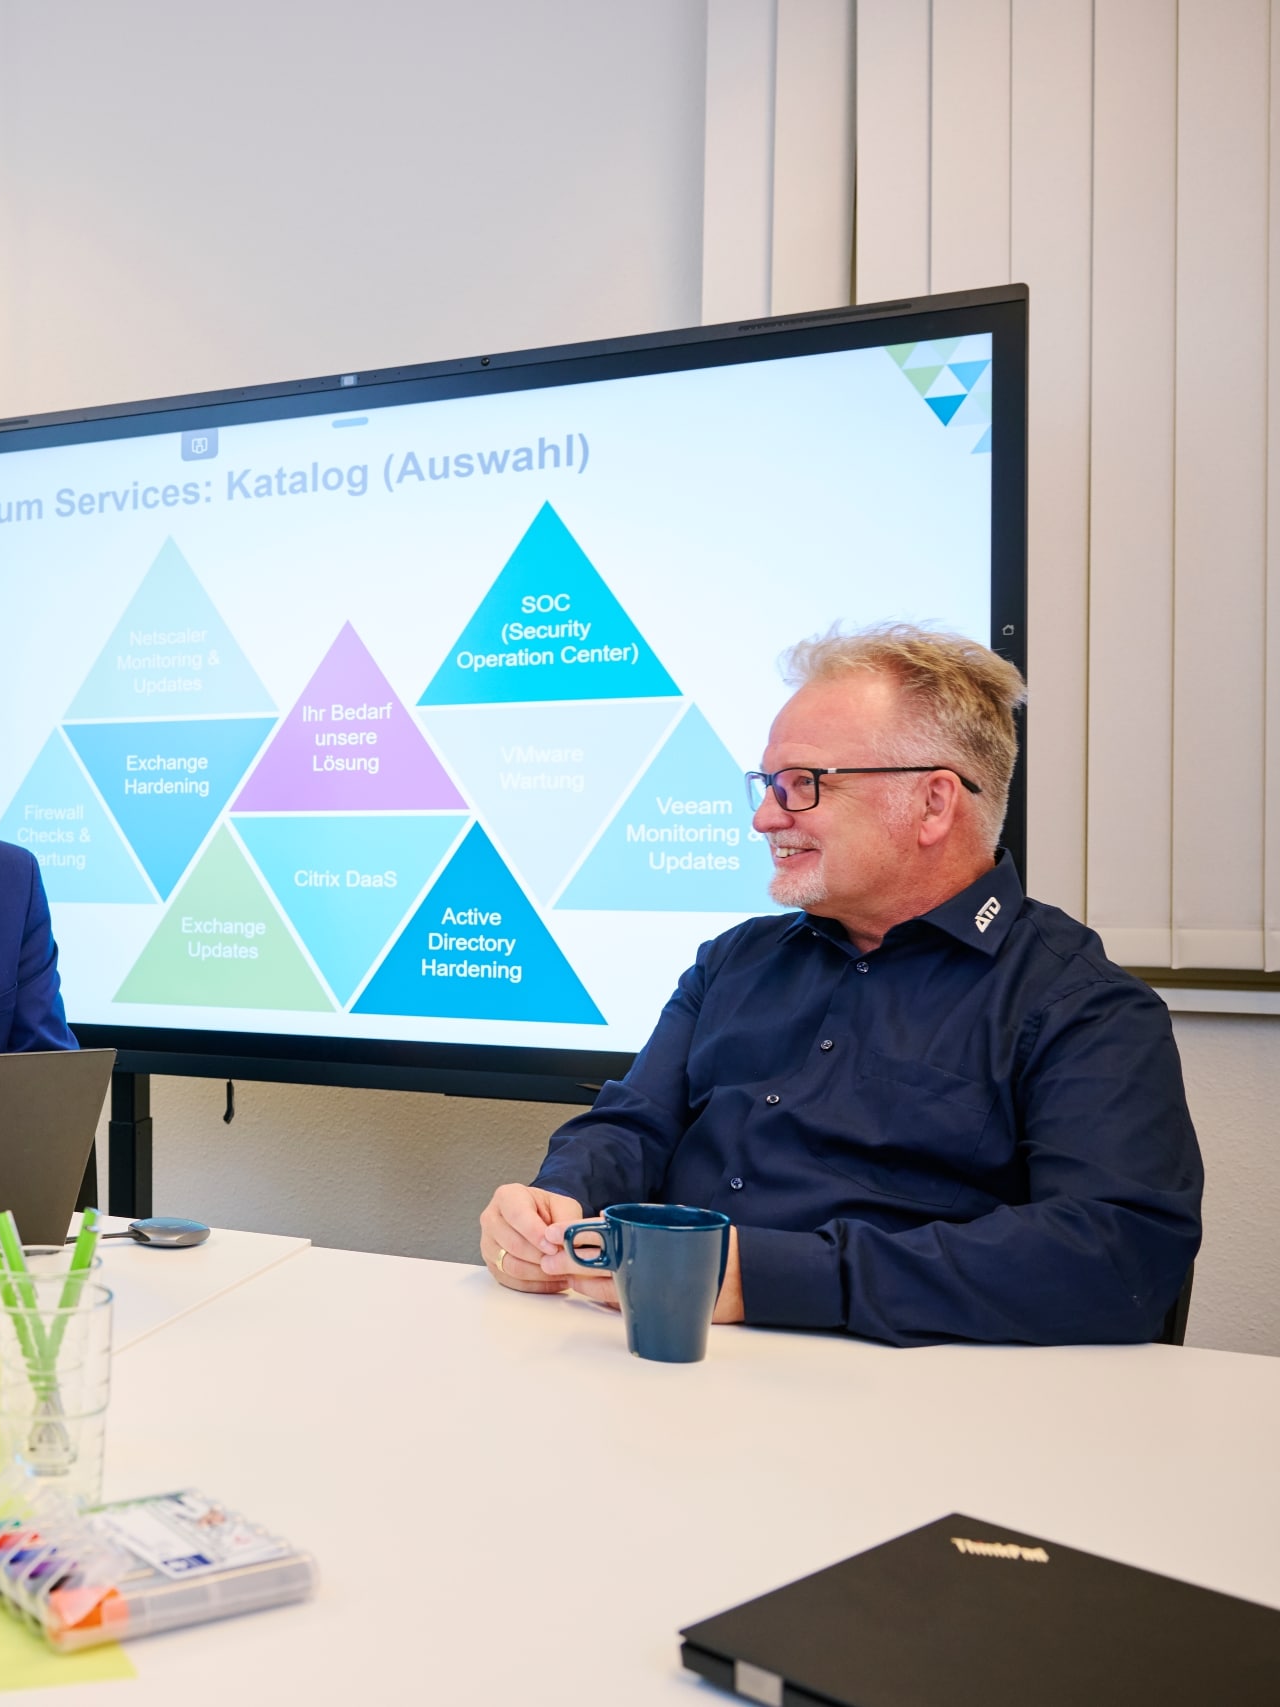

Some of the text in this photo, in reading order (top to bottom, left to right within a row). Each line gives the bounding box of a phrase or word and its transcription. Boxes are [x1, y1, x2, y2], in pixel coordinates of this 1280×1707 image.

[55, 480, 213, 517] Services:
[226, 462, 369, 500] Katalog
[383, 433, 590, 492] (Auswahl)
[520, 594, 571, 614] SOC
[129, 628, 208, 647] Netscaler
[500, 620, 592, 645] (Security
[117, 650, 202, 671] Monitoring
[456, 642, 639, 672] Operation Center)
[133, 676, 203, 695] Updates
[302, 702, 393, 723] Ihr Bedarf
[314, 730, 377, 746] unsere
[125, 754, 209, 774] Exchange
[312, 754, 380, 775] Lösung
[500, 745, 584, 763] VMware
[124, 779, 210, 797] Hardening
[499, 770, 585, 793] Wartung
[24, 804, 84, 821] Firewall
[655, 797, 733, 815] Veeam
[17, 827, 74, 843] Checks
[626, 823, 740, 846] Monitoring
[34, 849, 86, 870] artung
[649, 851, 740, 873] Updates
[294, 869, 398, 888] Citrix DaaS
[180, 916, 266, 937] Exchange
[441, 907, 502, 926] Active
[187, 941, 259, 960] Updates
[428, 932, 516, 956] Directory
[421, 958, 522, 983] Hardening
[950, 1537, 1050, 1563] ThinkPad
